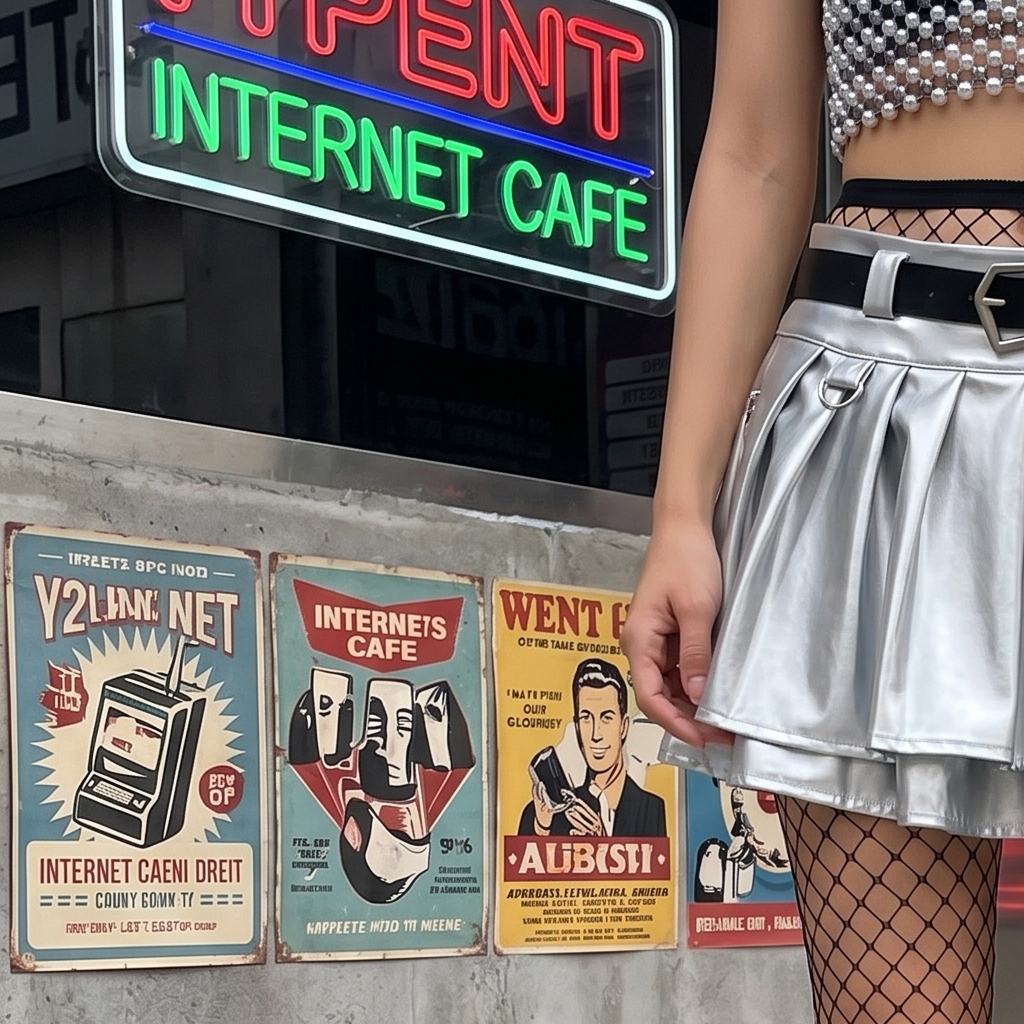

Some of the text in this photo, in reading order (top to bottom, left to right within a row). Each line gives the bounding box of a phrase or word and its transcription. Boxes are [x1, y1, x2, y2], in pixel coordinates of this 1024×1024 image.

[150, 57, 649, 263] INTERNET CAFE
[168, 589, 239, 654] NET
[499, 589, 603, 638] WENT
[347, 635, 418, 662] CAFE
[39, 858, 243, 884] INTERNET CAENI DREIT
